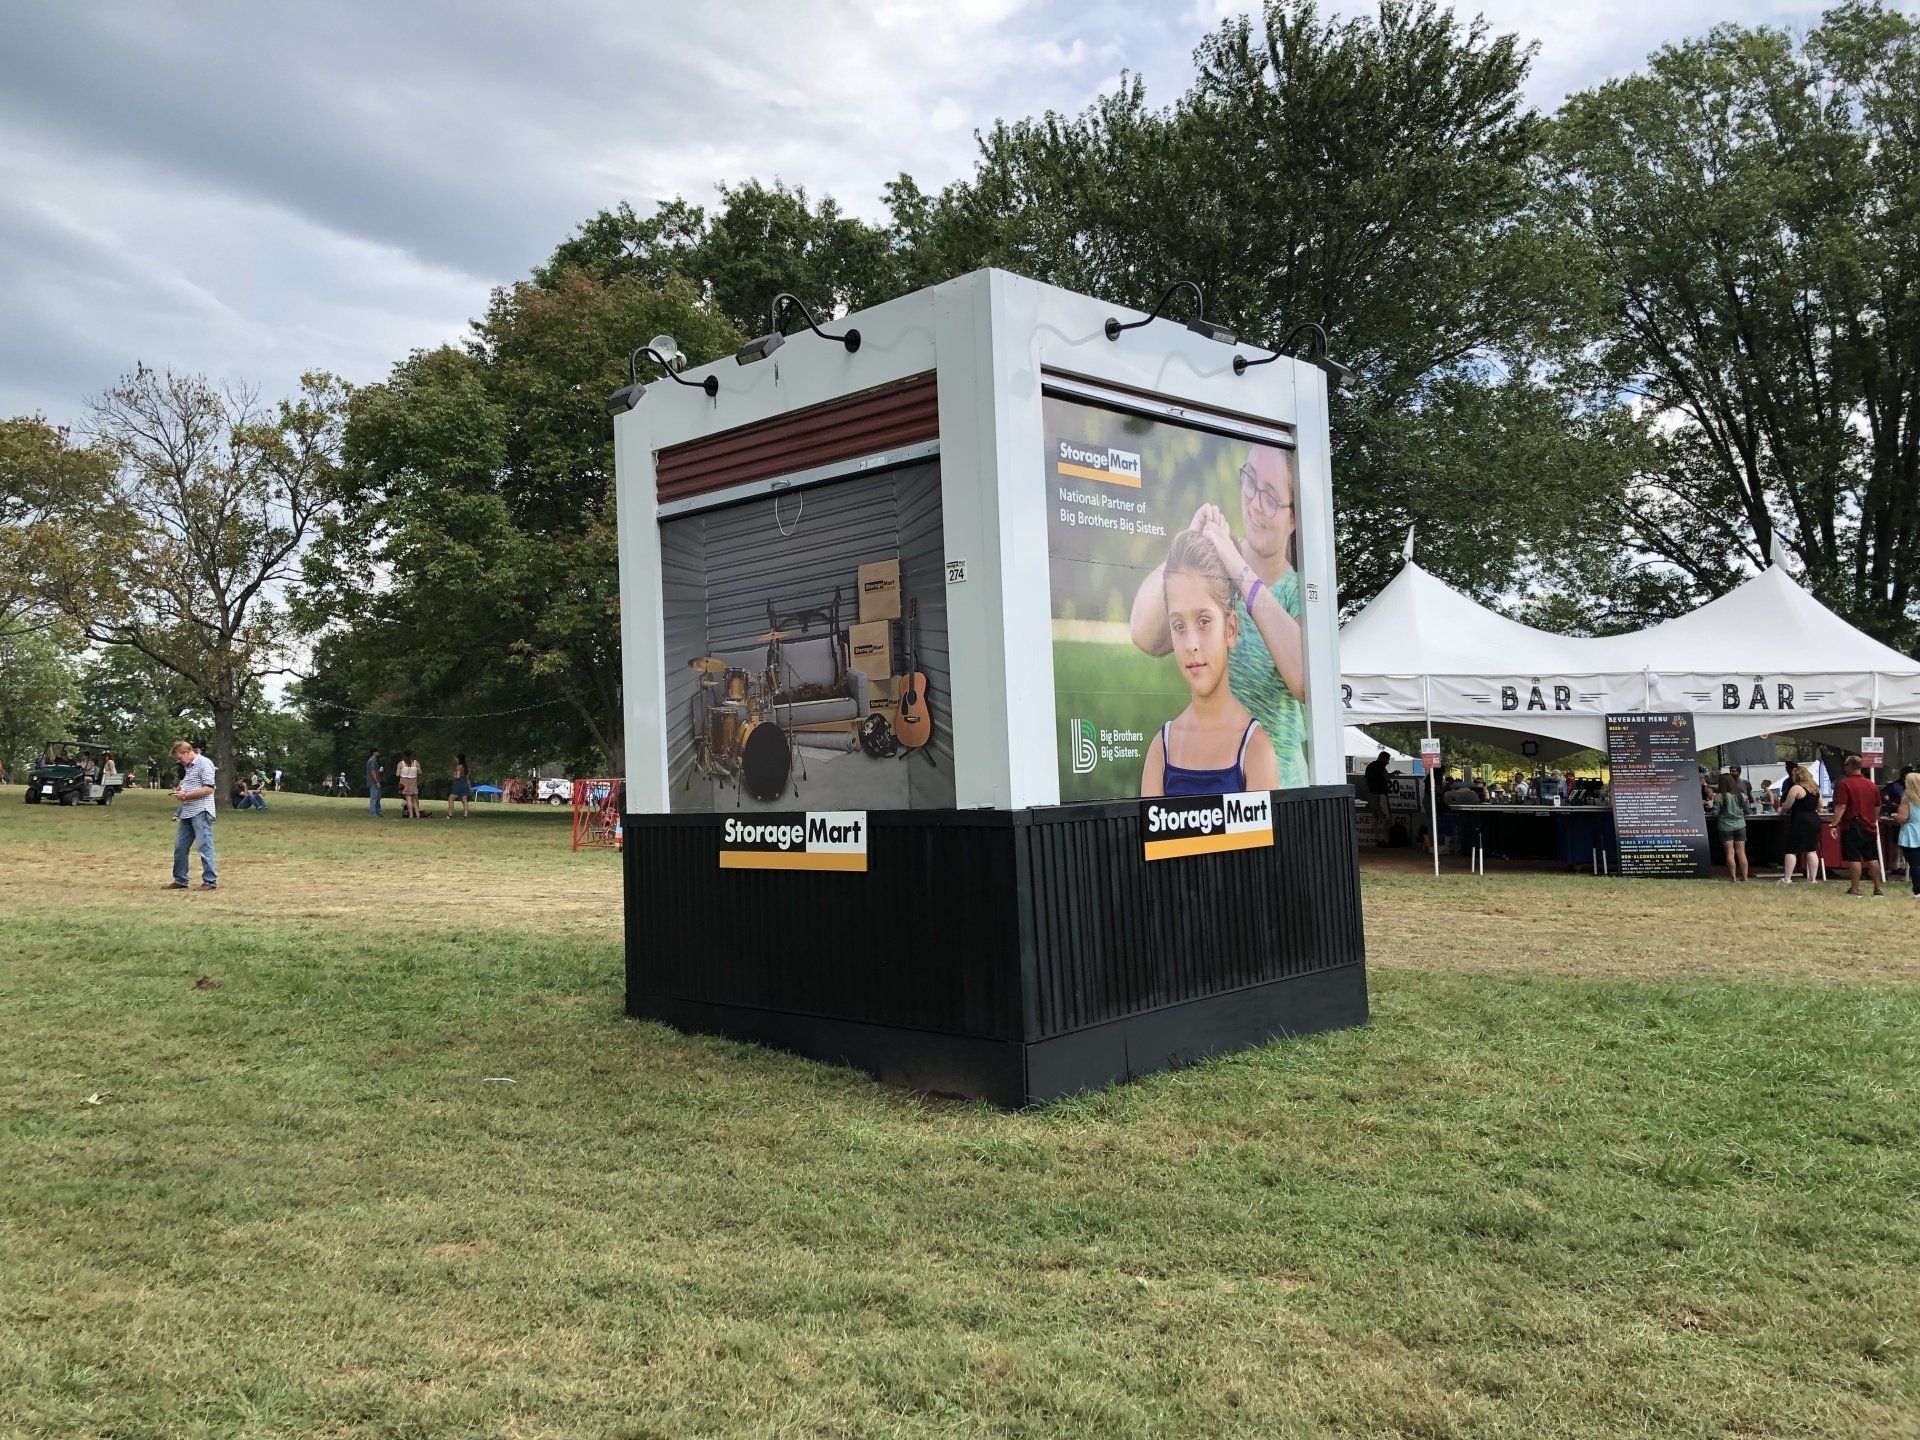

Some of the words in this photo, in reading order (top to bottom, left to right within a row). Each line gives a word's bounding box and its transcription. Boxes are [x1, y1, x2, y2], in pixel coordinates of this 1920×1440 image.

[1059, 487, 1100, 506] National
[1101, 495, 1135, 512] Partner
[1136, 501, 1147, 514] of
[1060, 508, 1076, 526] Big
[1078, 511, 1118, 530] Brothers
[1119, 517, 1135, 534] Big
[1136, 520, 1167, 536] Sisters.
[948, 568, 965, 581] 274
[1100, 729, 1112, 745] Big
[1113, 729, 1144, 742] Brothers
[1101, 746, 1114, 762] Big
[1114, 746, 1141, 758] Sisters.
